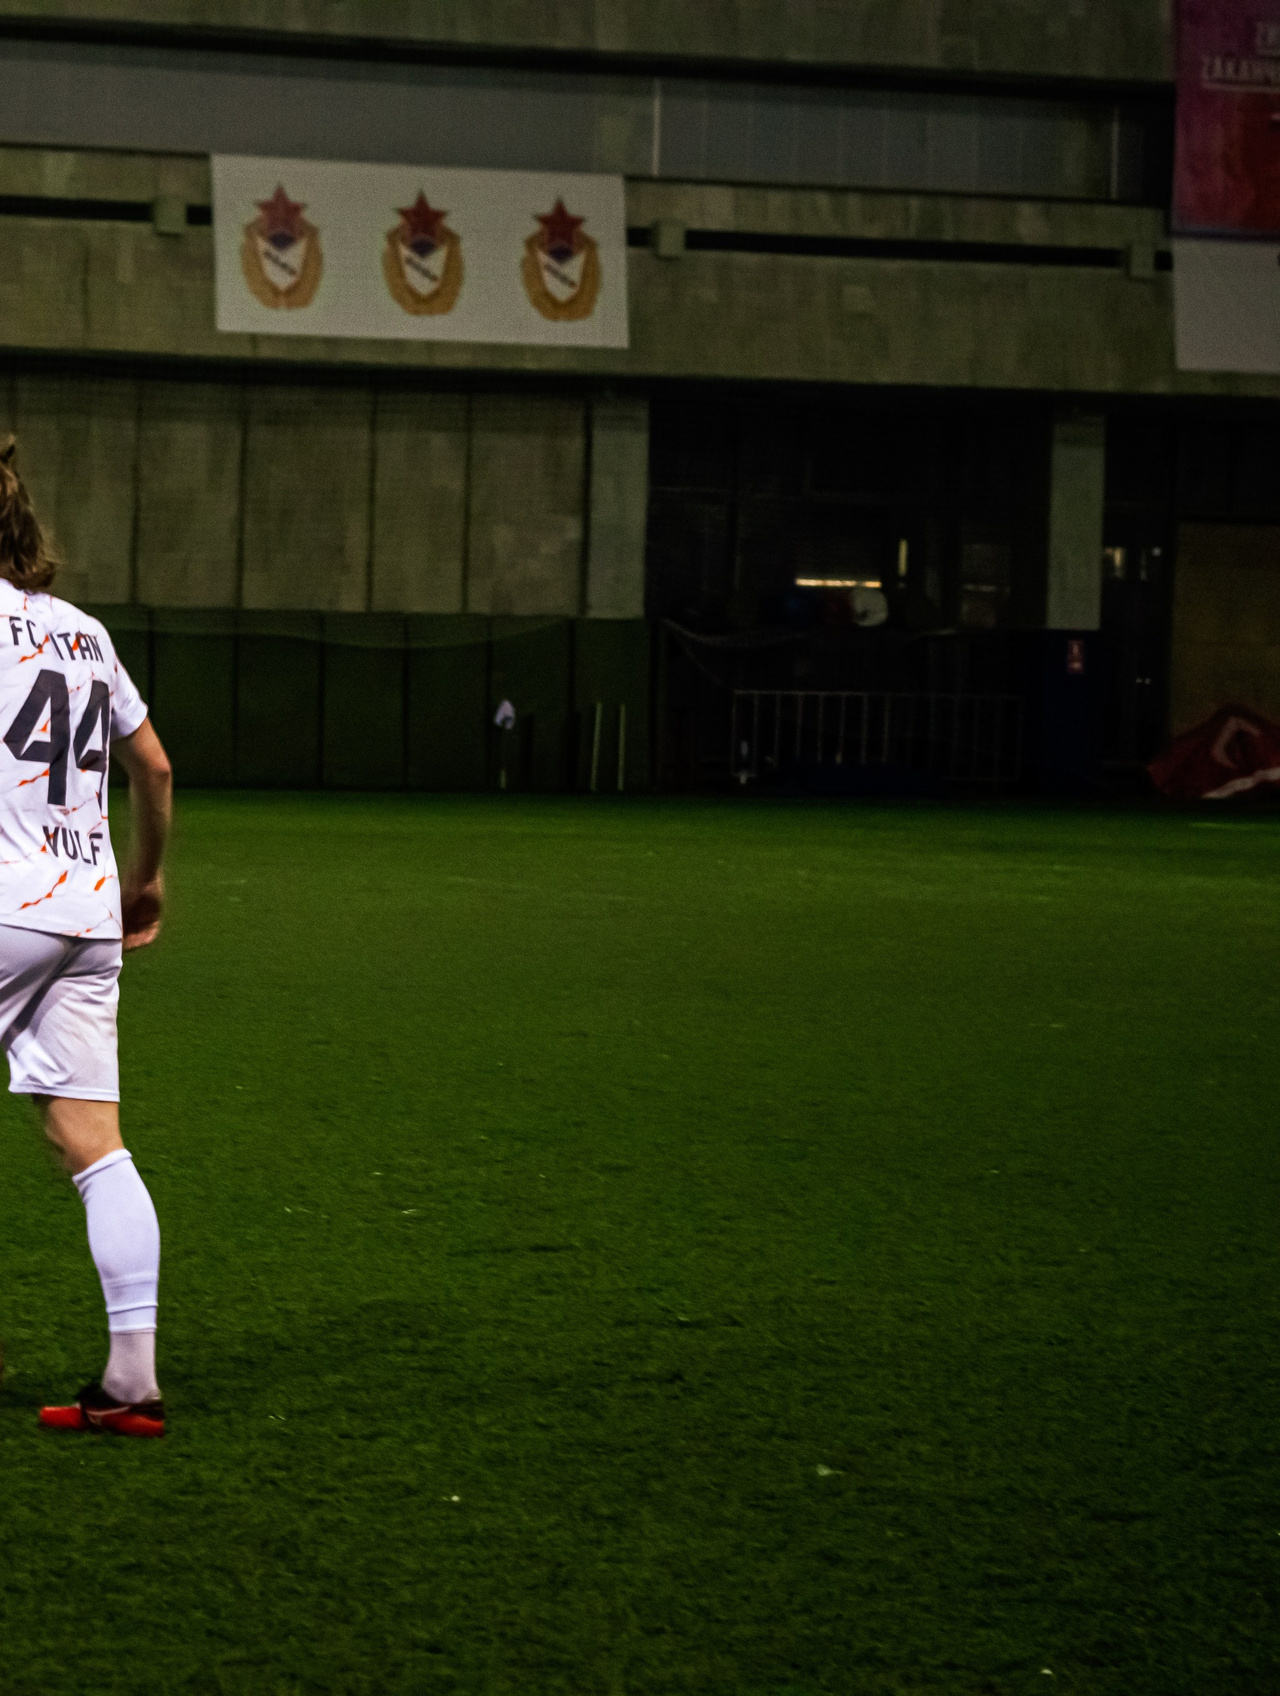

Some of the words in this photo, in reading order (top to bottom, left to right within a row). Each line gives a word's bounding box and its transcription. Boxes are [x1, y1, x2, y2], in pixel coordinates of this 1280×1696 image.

[9, 616, 43, 649] FC
[3, 669, 110, 812] 44
[42, 825, 103, 866] VULF
